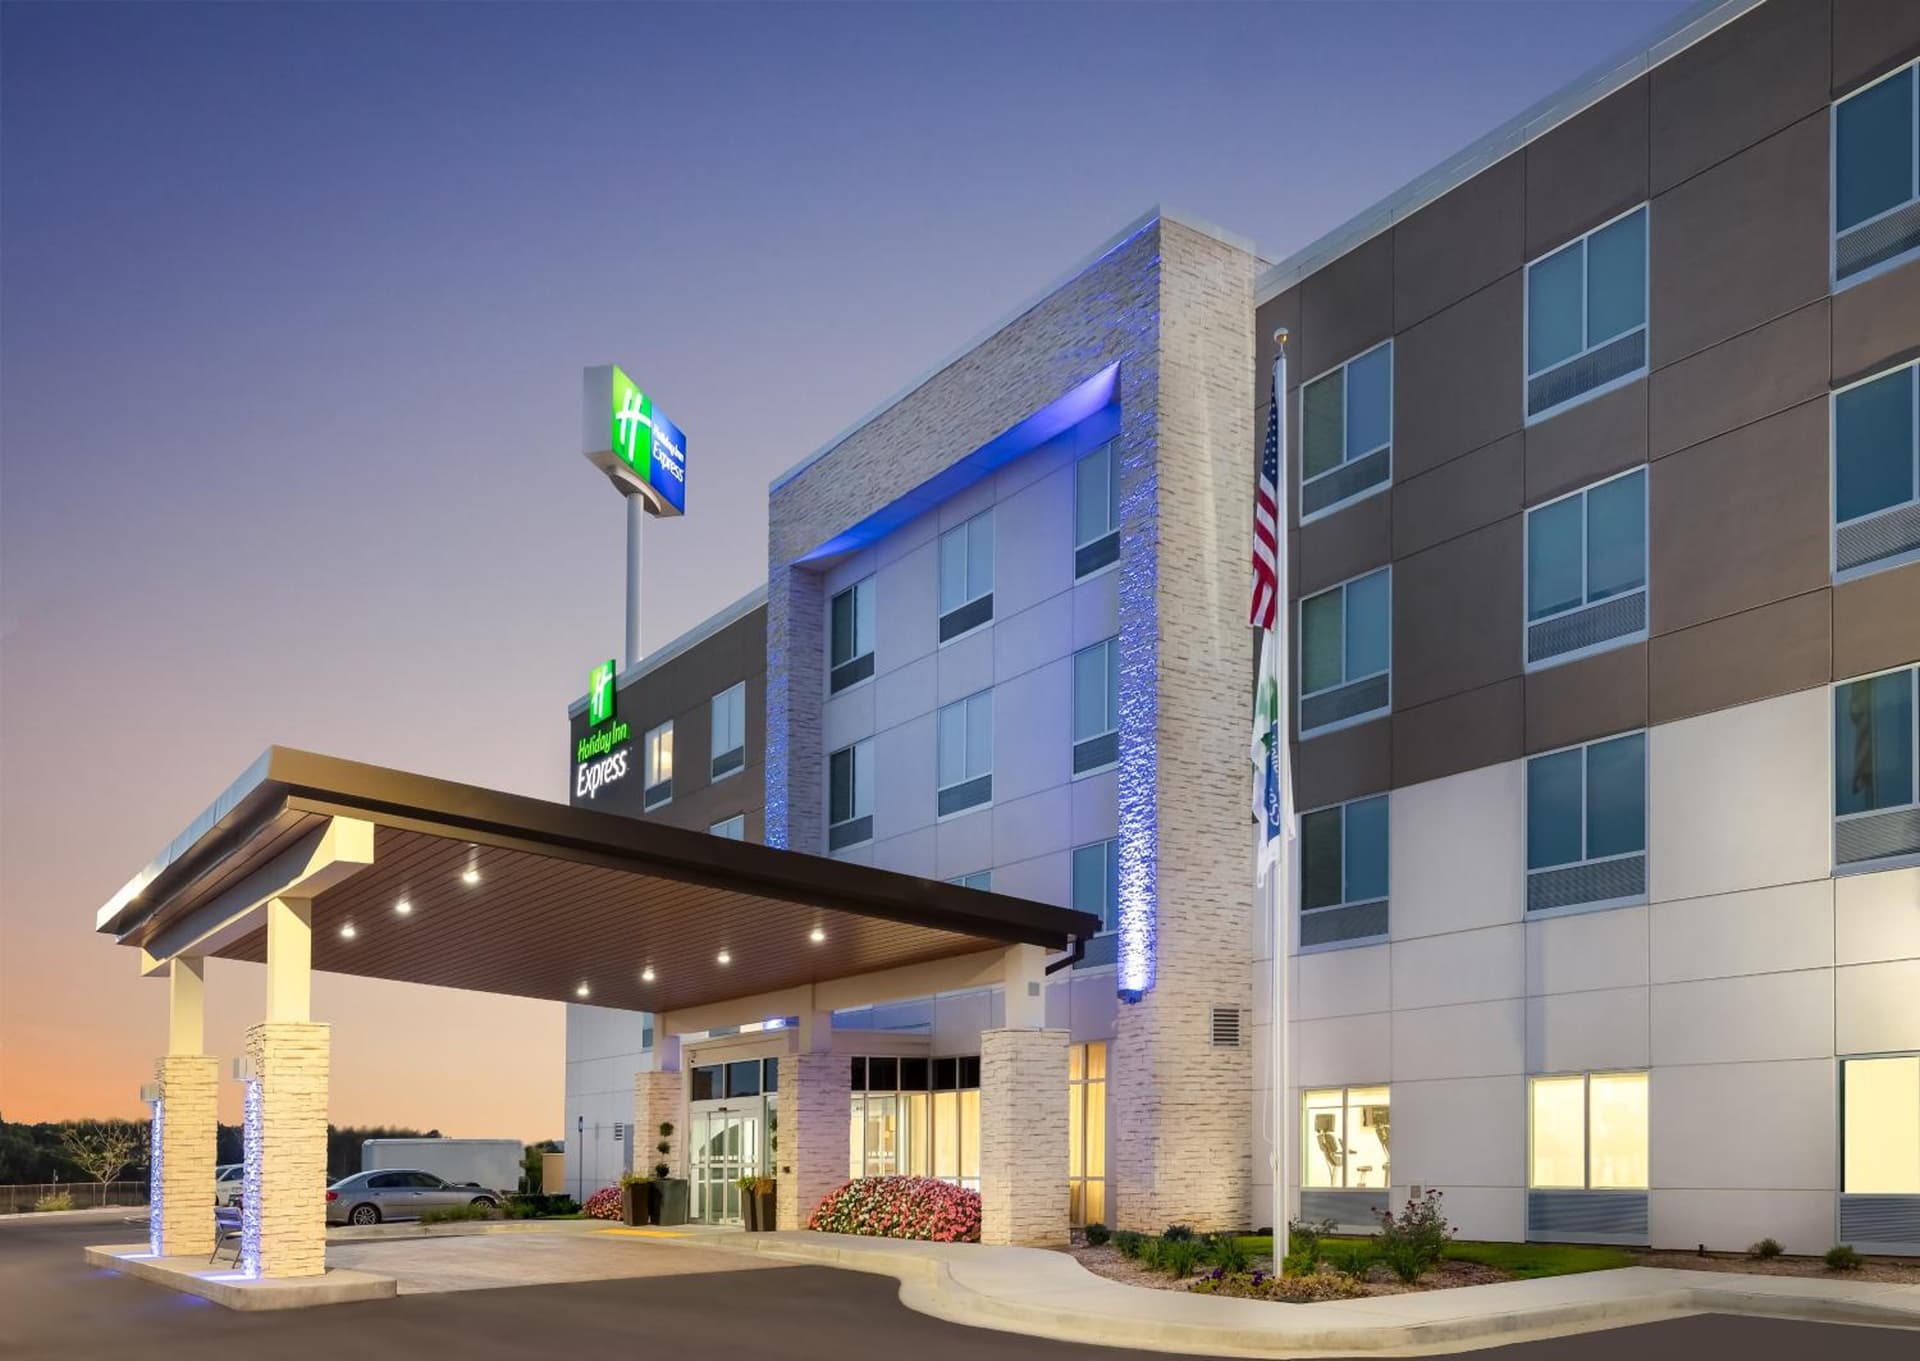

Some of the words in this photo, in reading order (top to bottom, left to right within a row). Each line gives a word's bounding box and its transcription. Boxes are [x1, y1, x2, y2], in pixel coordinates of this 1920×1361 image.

[653, 440, 684, 482] Express
[578, 729, 611, 763] Holiday
[612, 720, 627, 745] Inn
[577, 750, 628, 799] Express
